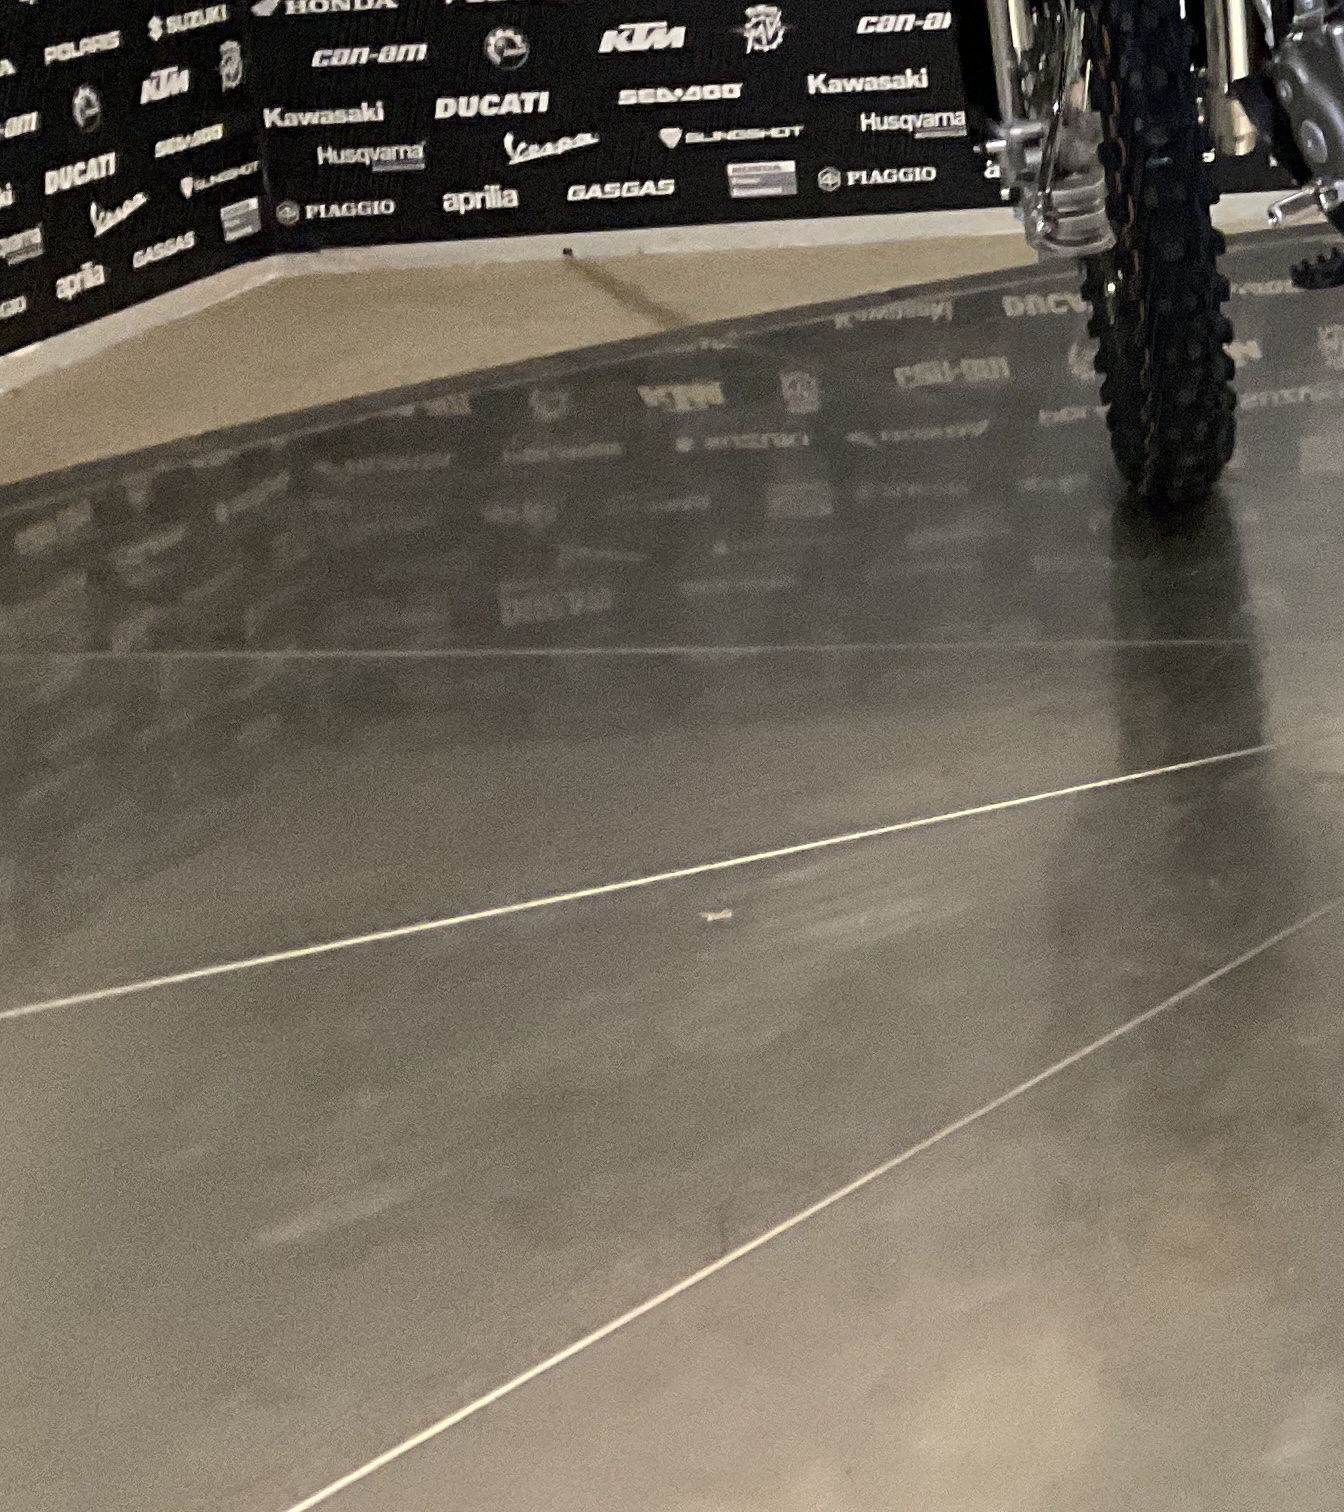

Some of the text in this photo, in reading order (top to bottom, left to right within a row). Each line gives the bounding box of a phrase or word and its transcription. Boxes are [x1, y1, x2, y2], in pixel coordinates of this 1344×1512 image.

[166, 4, 227, 34] SUZUKI
[598, 21, 686, 53] KTM
[140, 66, 189, 104] KTM
[807, 68, 928, 94] Kawasaki
[263, 101, 384, 128] Kawasaki
[435, 91, 549, 119] DUCATI
[860, 111, 967, 133] Husqvarna
[317, 141, 425, 165] Husqvarna
[45, 152, 116, 195] DUCATI
[847, 167, 936, 185] PIAGGIO
[443, 185, 519, 214] aprilia
[567, 179, 675, 201] GASGAS
[306, 199, 395, 219] PIAGGIO
